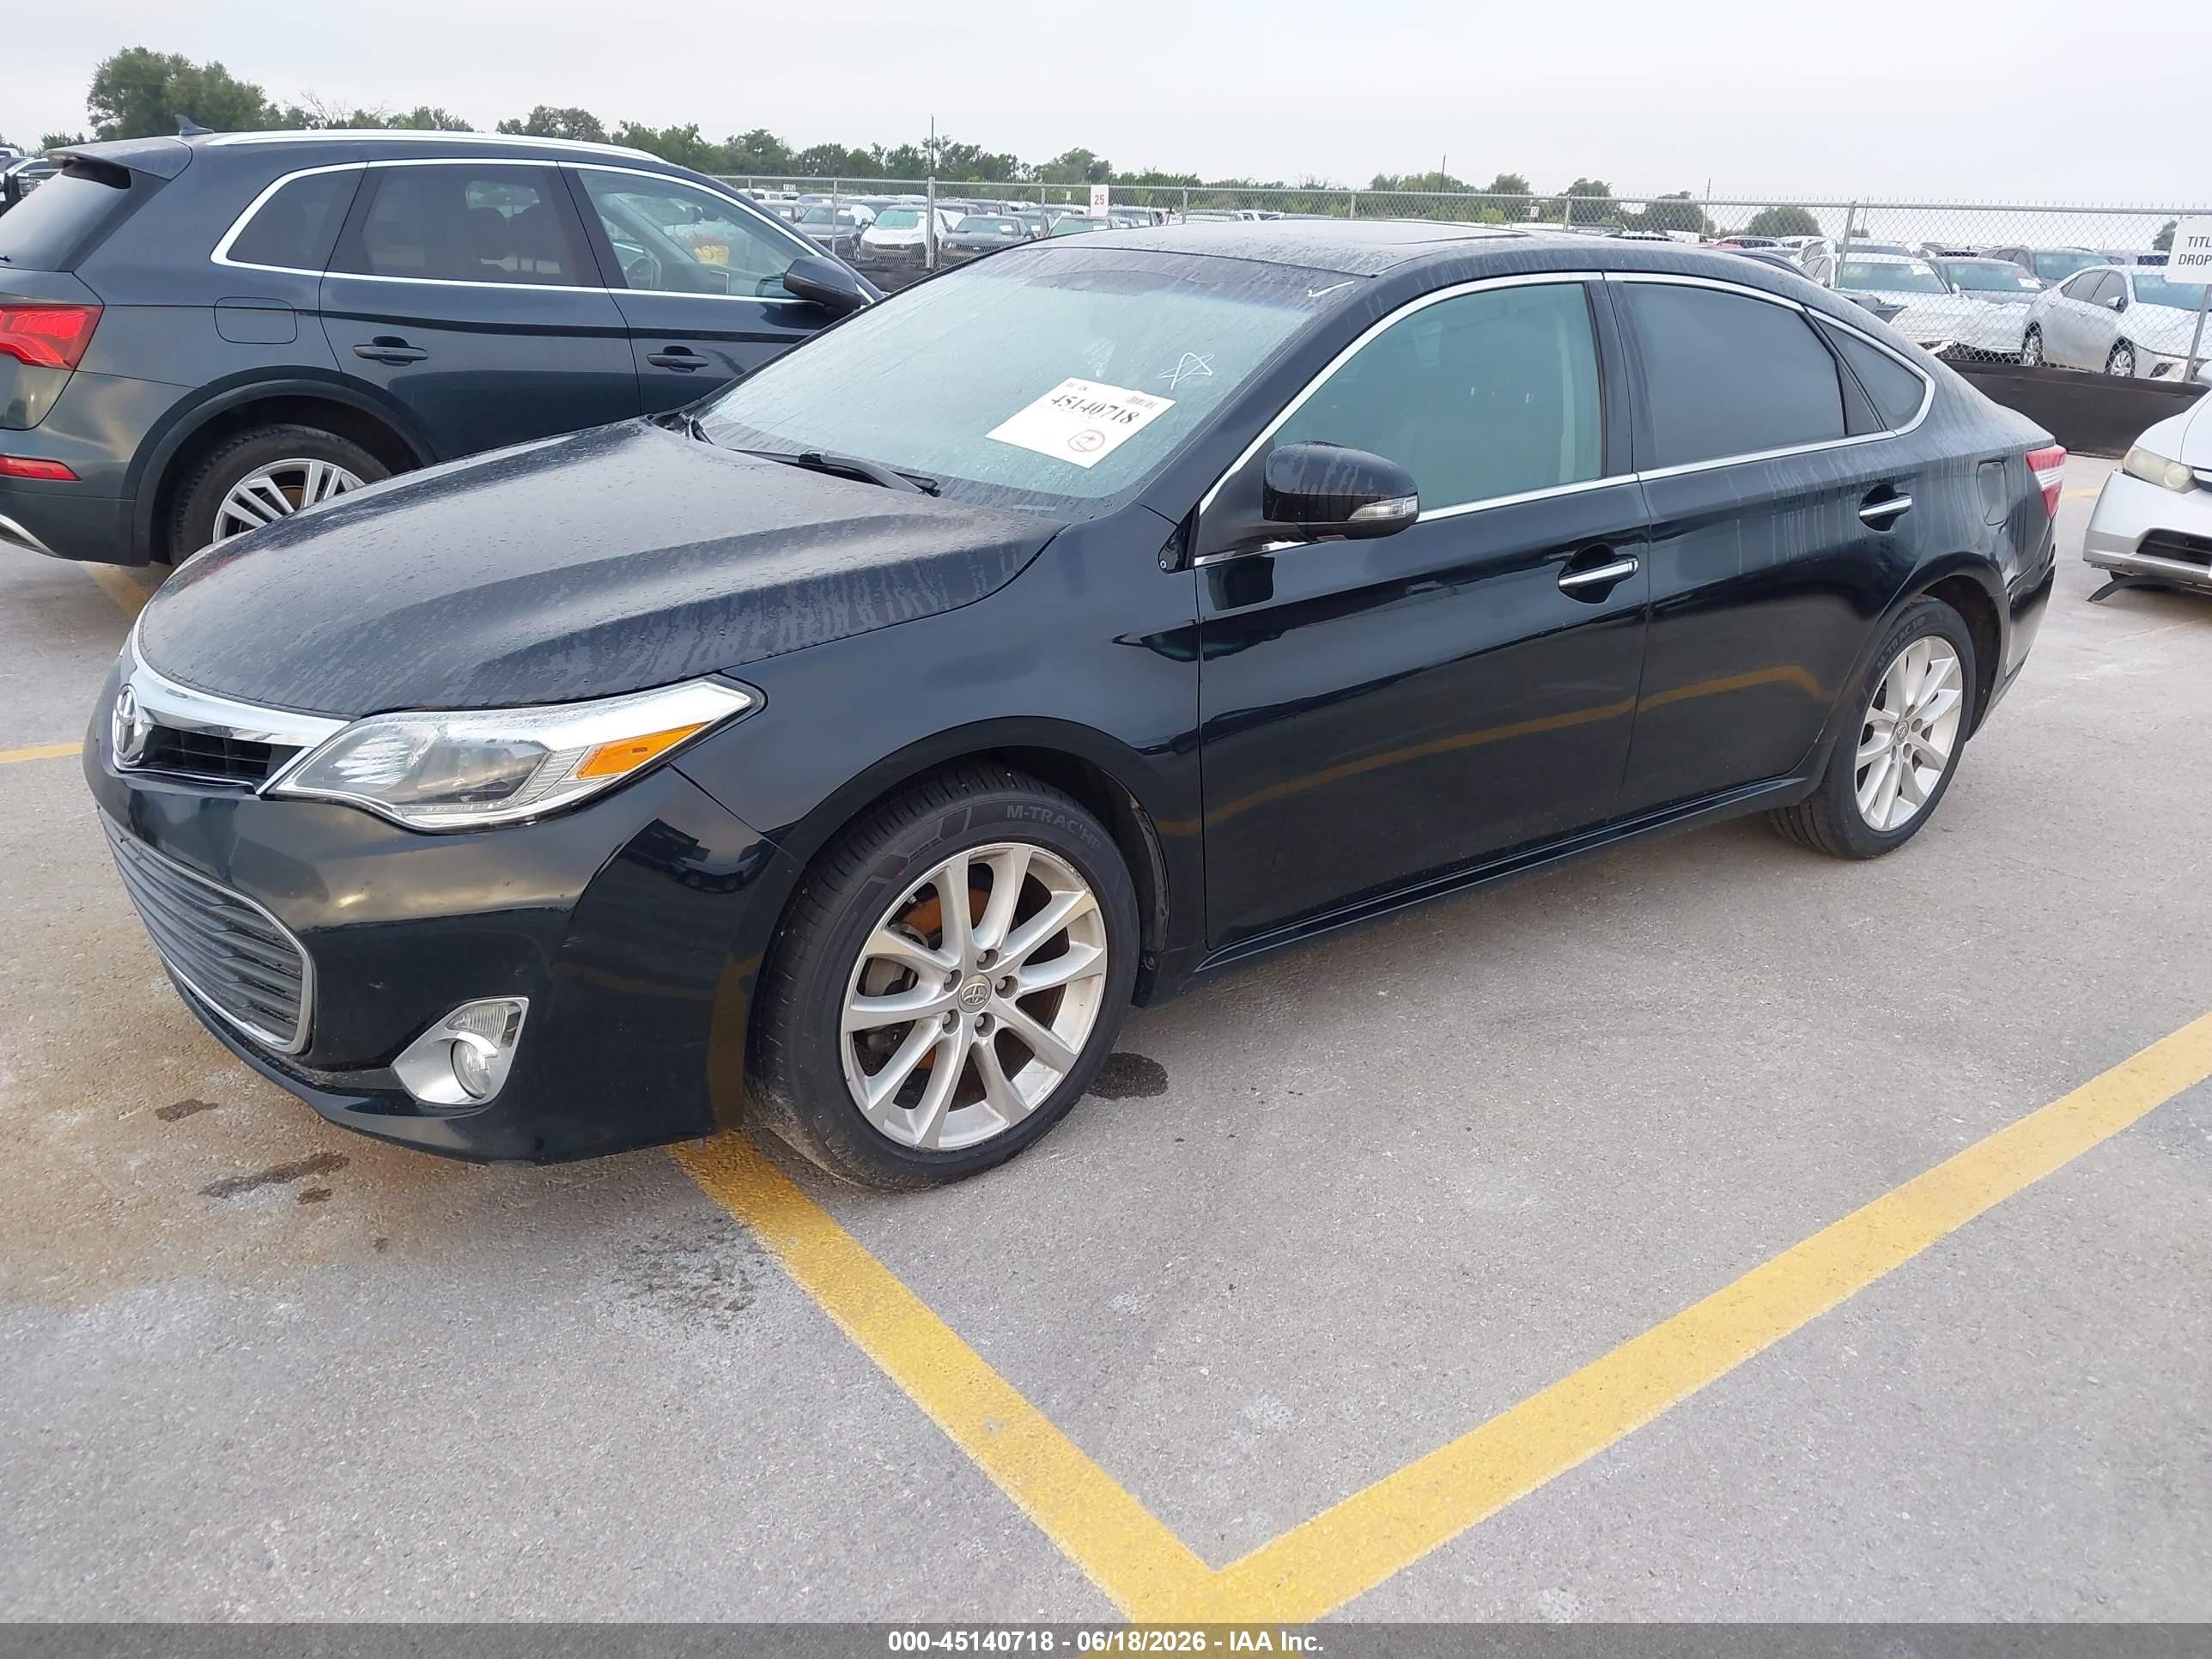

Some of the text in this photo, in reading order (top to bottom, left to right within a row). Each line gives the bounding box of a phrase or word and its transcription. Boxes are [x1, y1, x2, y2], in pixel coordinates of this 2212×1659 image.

[1094, 194, 1104, 205] 25
[2178, 253, 2212, 265] DROP
[1051, 394, 1139, 424] 45140718
[1006, 805, 1079, 834] M-TRAC
